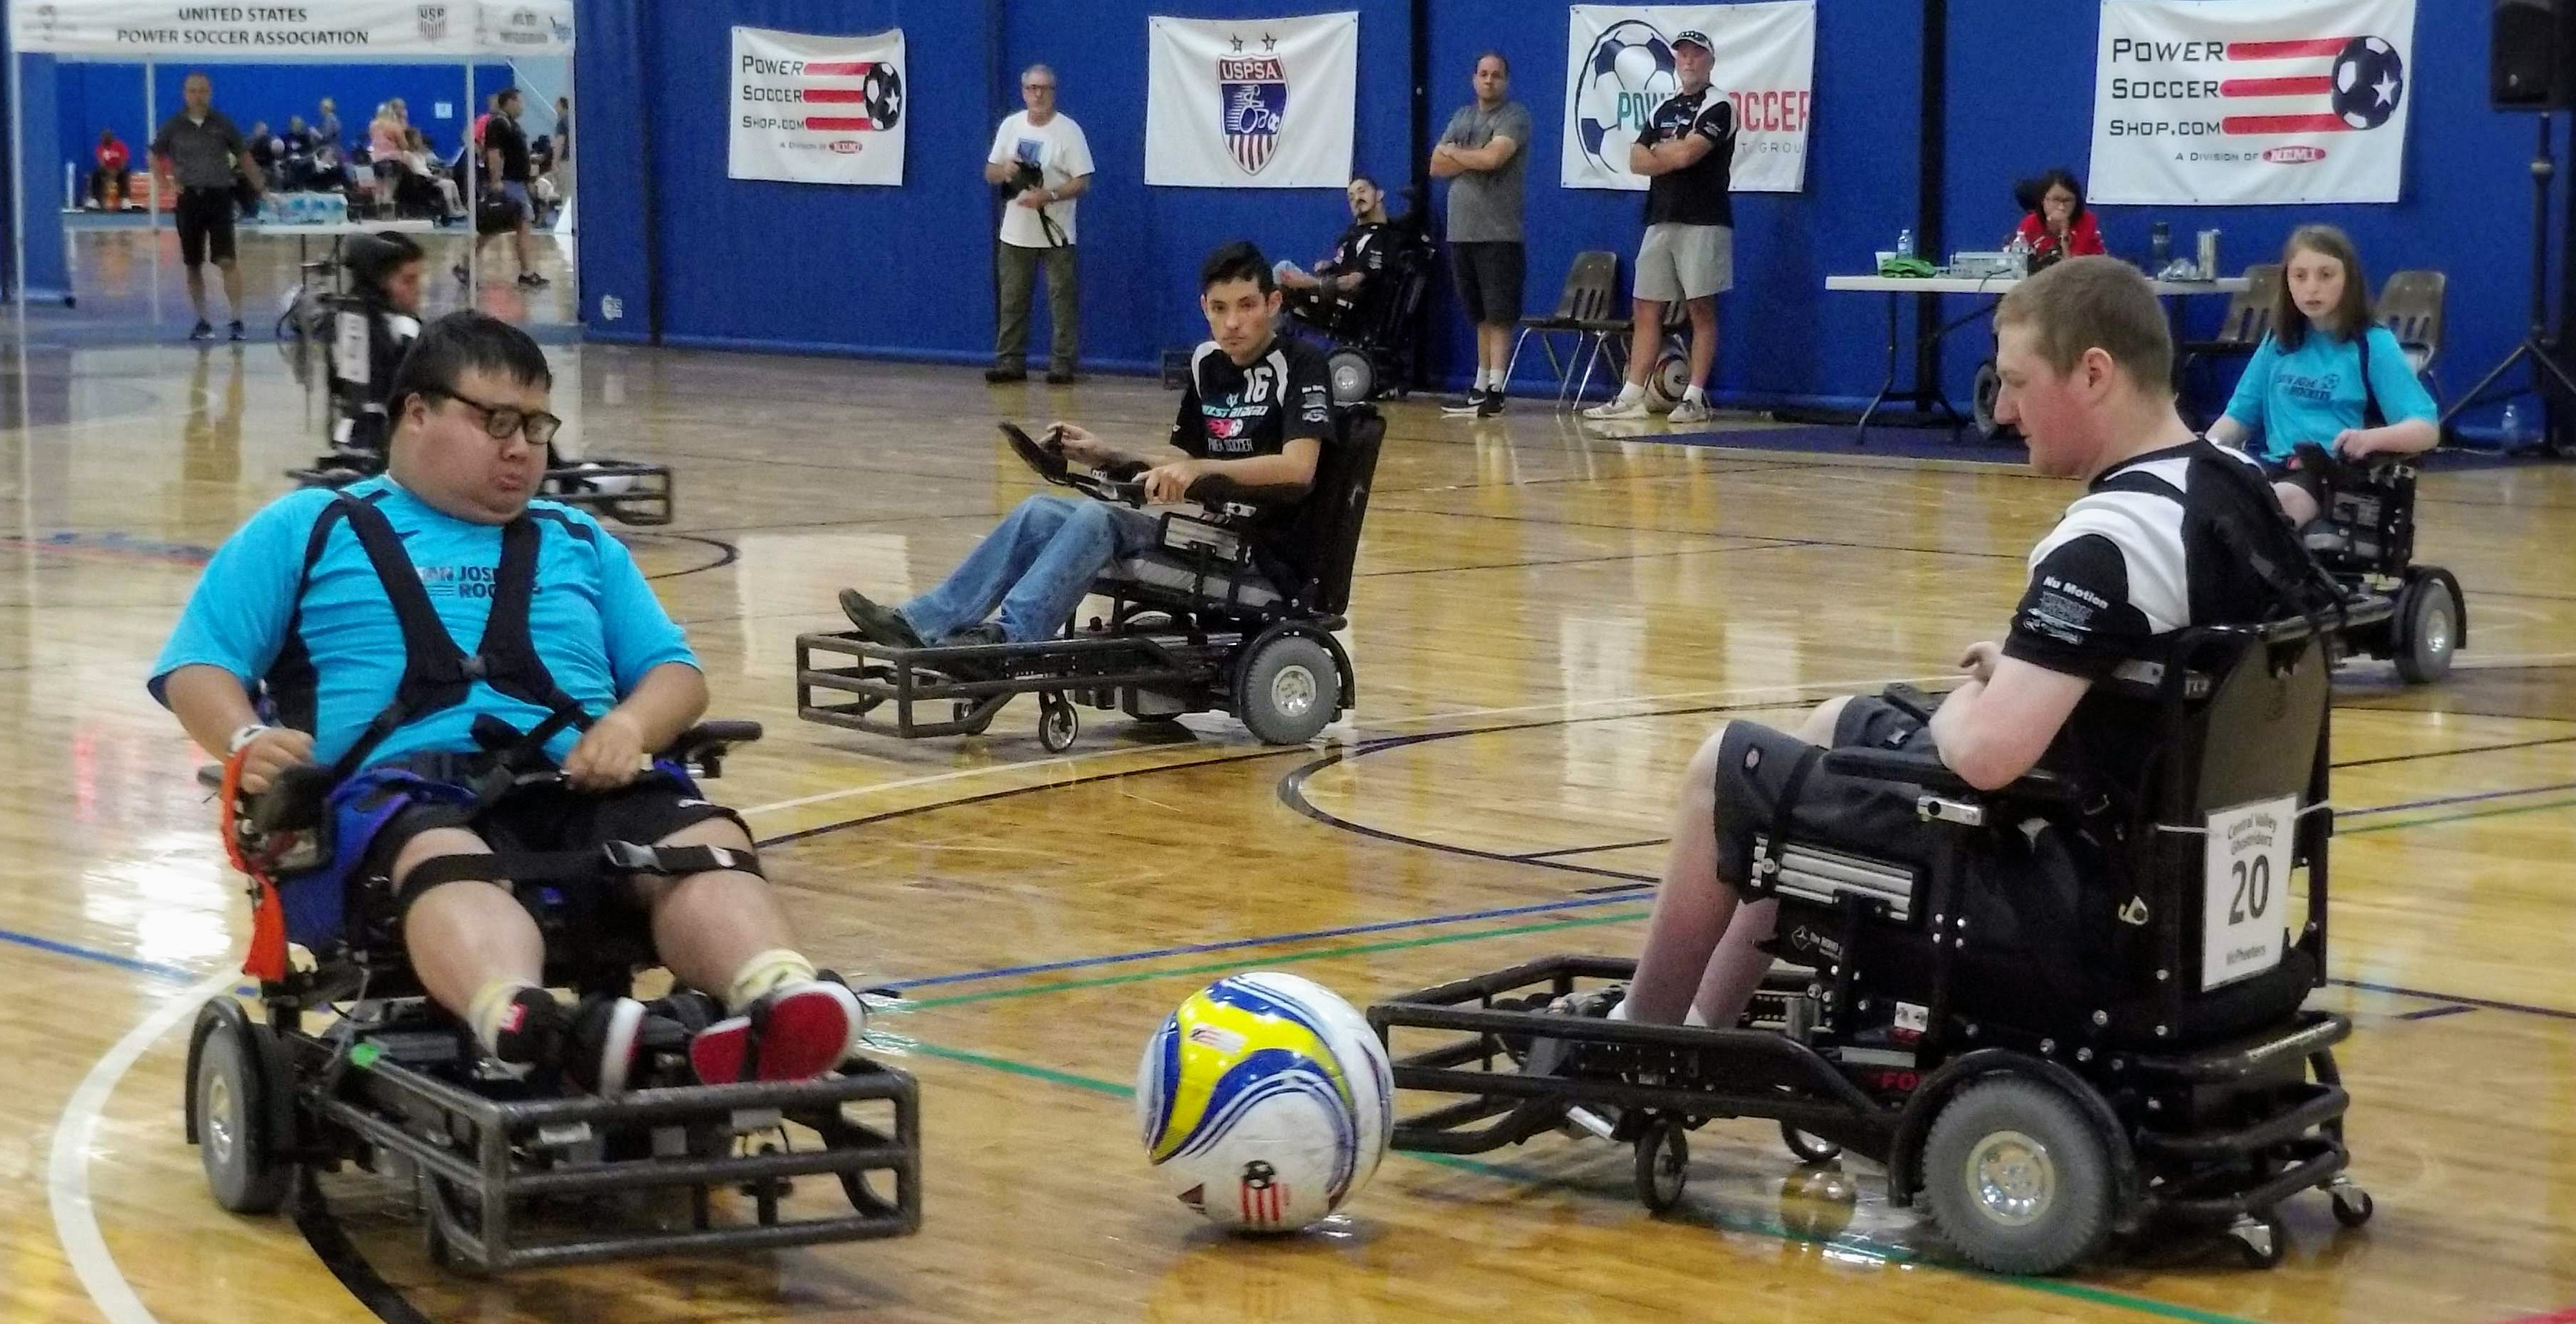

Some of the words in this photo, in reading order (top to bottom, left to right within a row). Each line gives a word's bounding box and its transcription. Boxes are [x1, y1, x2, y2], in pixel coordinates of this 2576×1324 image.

[178, 7, 243, 22] UNITED
[247, 8, 308, 22] STATES
[116, 29, 179, 44] POWER
[183, 30, 250, 44] SOCCER
[253, 30, 369, 45] ASSOCIATION
[2112, 38, 2224, 63] POWER
[742, 54, 804, 76] POWER
[1221, 62, 1279, 79] USPSA
[742, 84, 803, 103] SOCCER
[2111, 77, 2219, 99] SOCCER
[1617, 92, 1675, 131] PO
[1728, 91, 1809, 132] OCCER
[742, 115, 805, 130] SHOP.COM
[2109, 120, 2220, 136] SHOP.COM
[1760, 142, 1801, 153] GROU
[2175, 153, 2184, 161] A
[2244, 153, 2259, 161] OF
[1243, 366, 1273, 404] 16
[457, 566, 501, 582] JOS
[2043, 576, 2062, 589] Nu
[2063, 581, 2110, 609] Motion
[2228, 854, 2270, 926] 20
